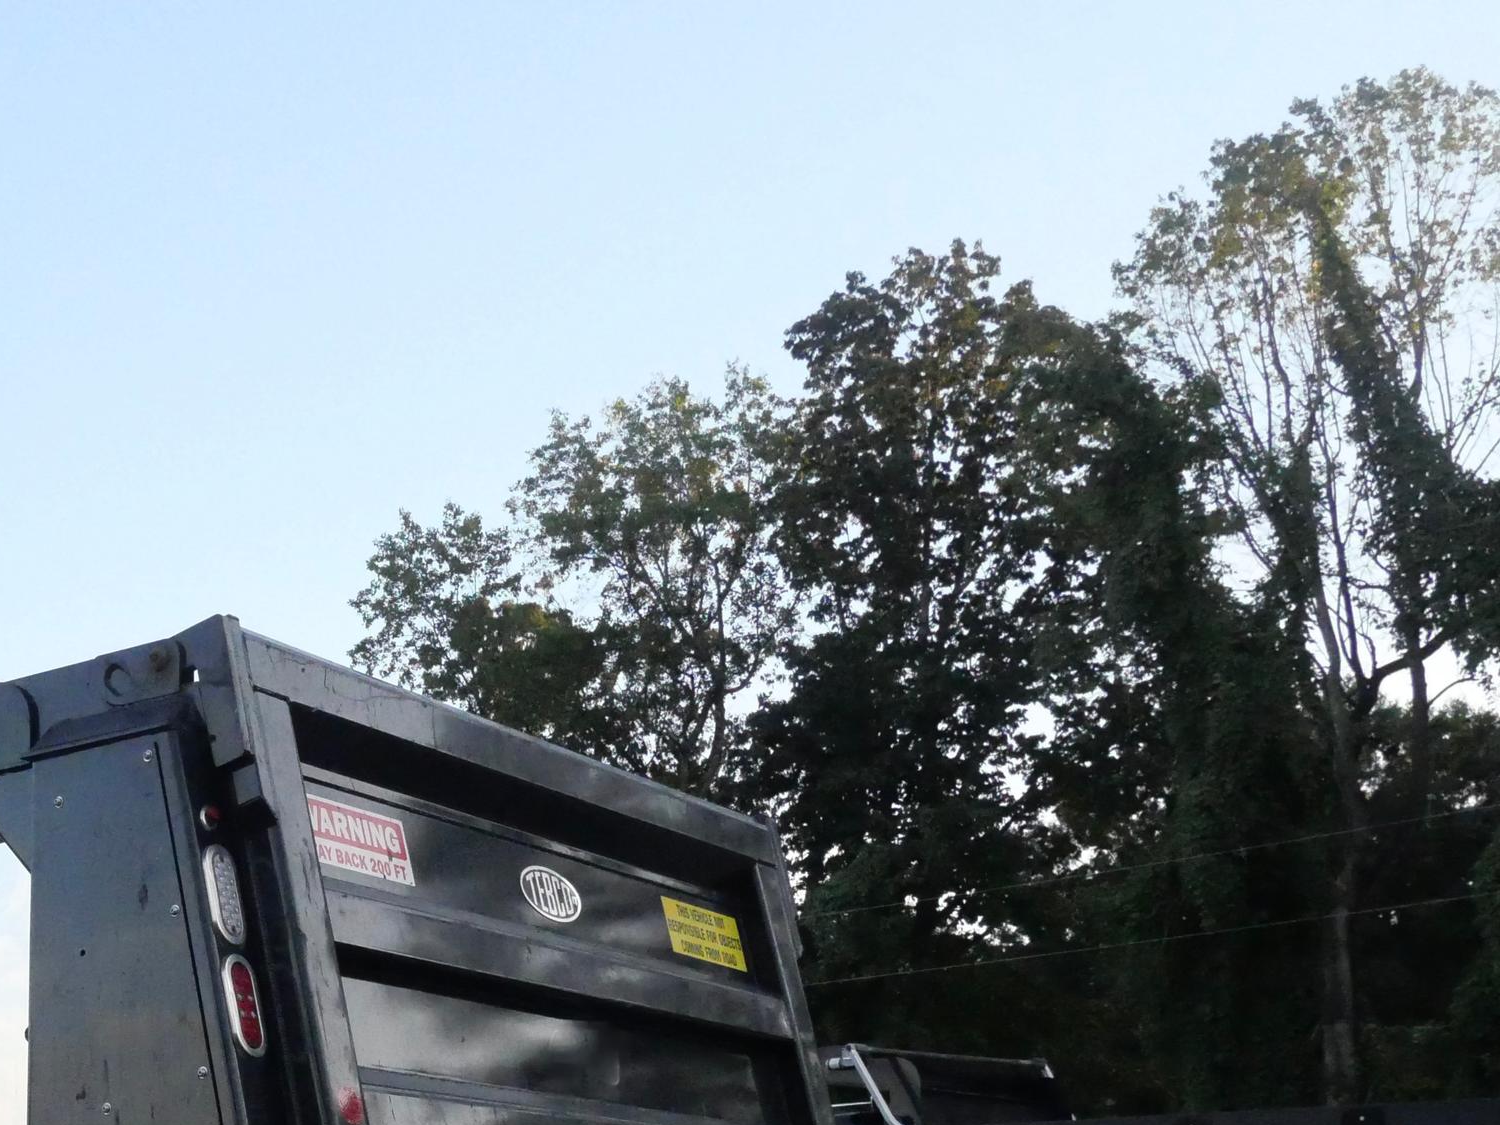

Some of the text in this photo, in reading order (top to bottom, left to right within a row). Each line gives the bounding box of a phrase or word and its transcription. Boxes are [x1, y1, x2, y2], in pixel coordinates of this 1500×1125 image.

[335, 849, 368, 871] BACK
[370, 859, 392, 876] 200
[394, 864, 407, 881] FT
